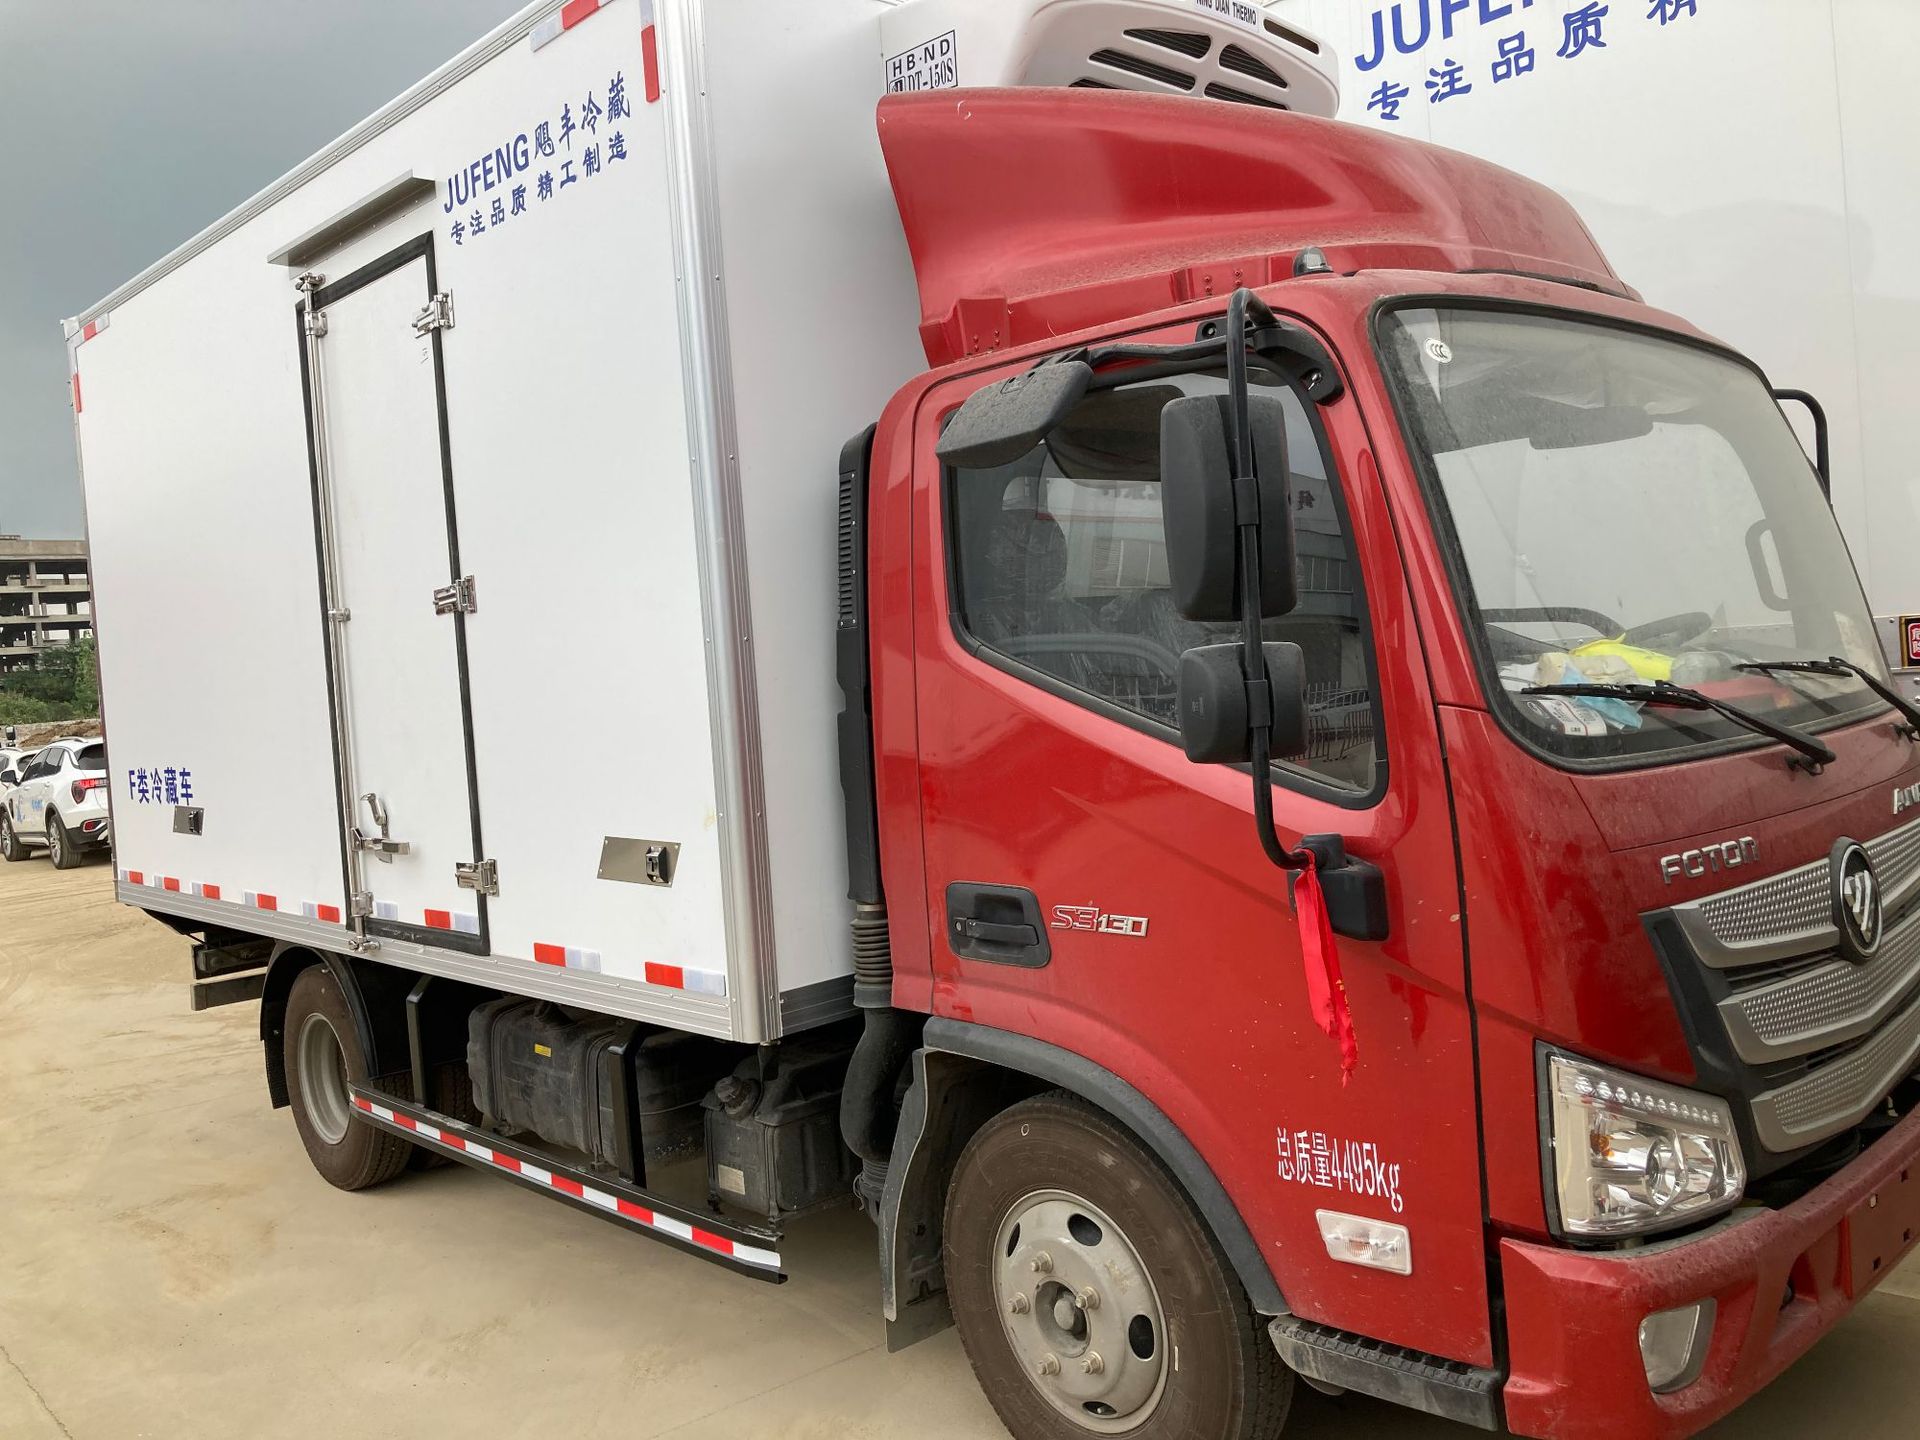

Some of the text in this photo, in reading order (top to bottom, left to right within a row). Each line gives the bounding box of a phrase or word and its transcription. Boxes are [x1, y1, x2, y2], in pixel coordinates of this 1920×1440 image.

[128, 766, 194, 806] F类冷藏车
[1660, 835, 1760, 884] FOTON
[1276, 1126, 1404, 1213] 总质量4495kg
